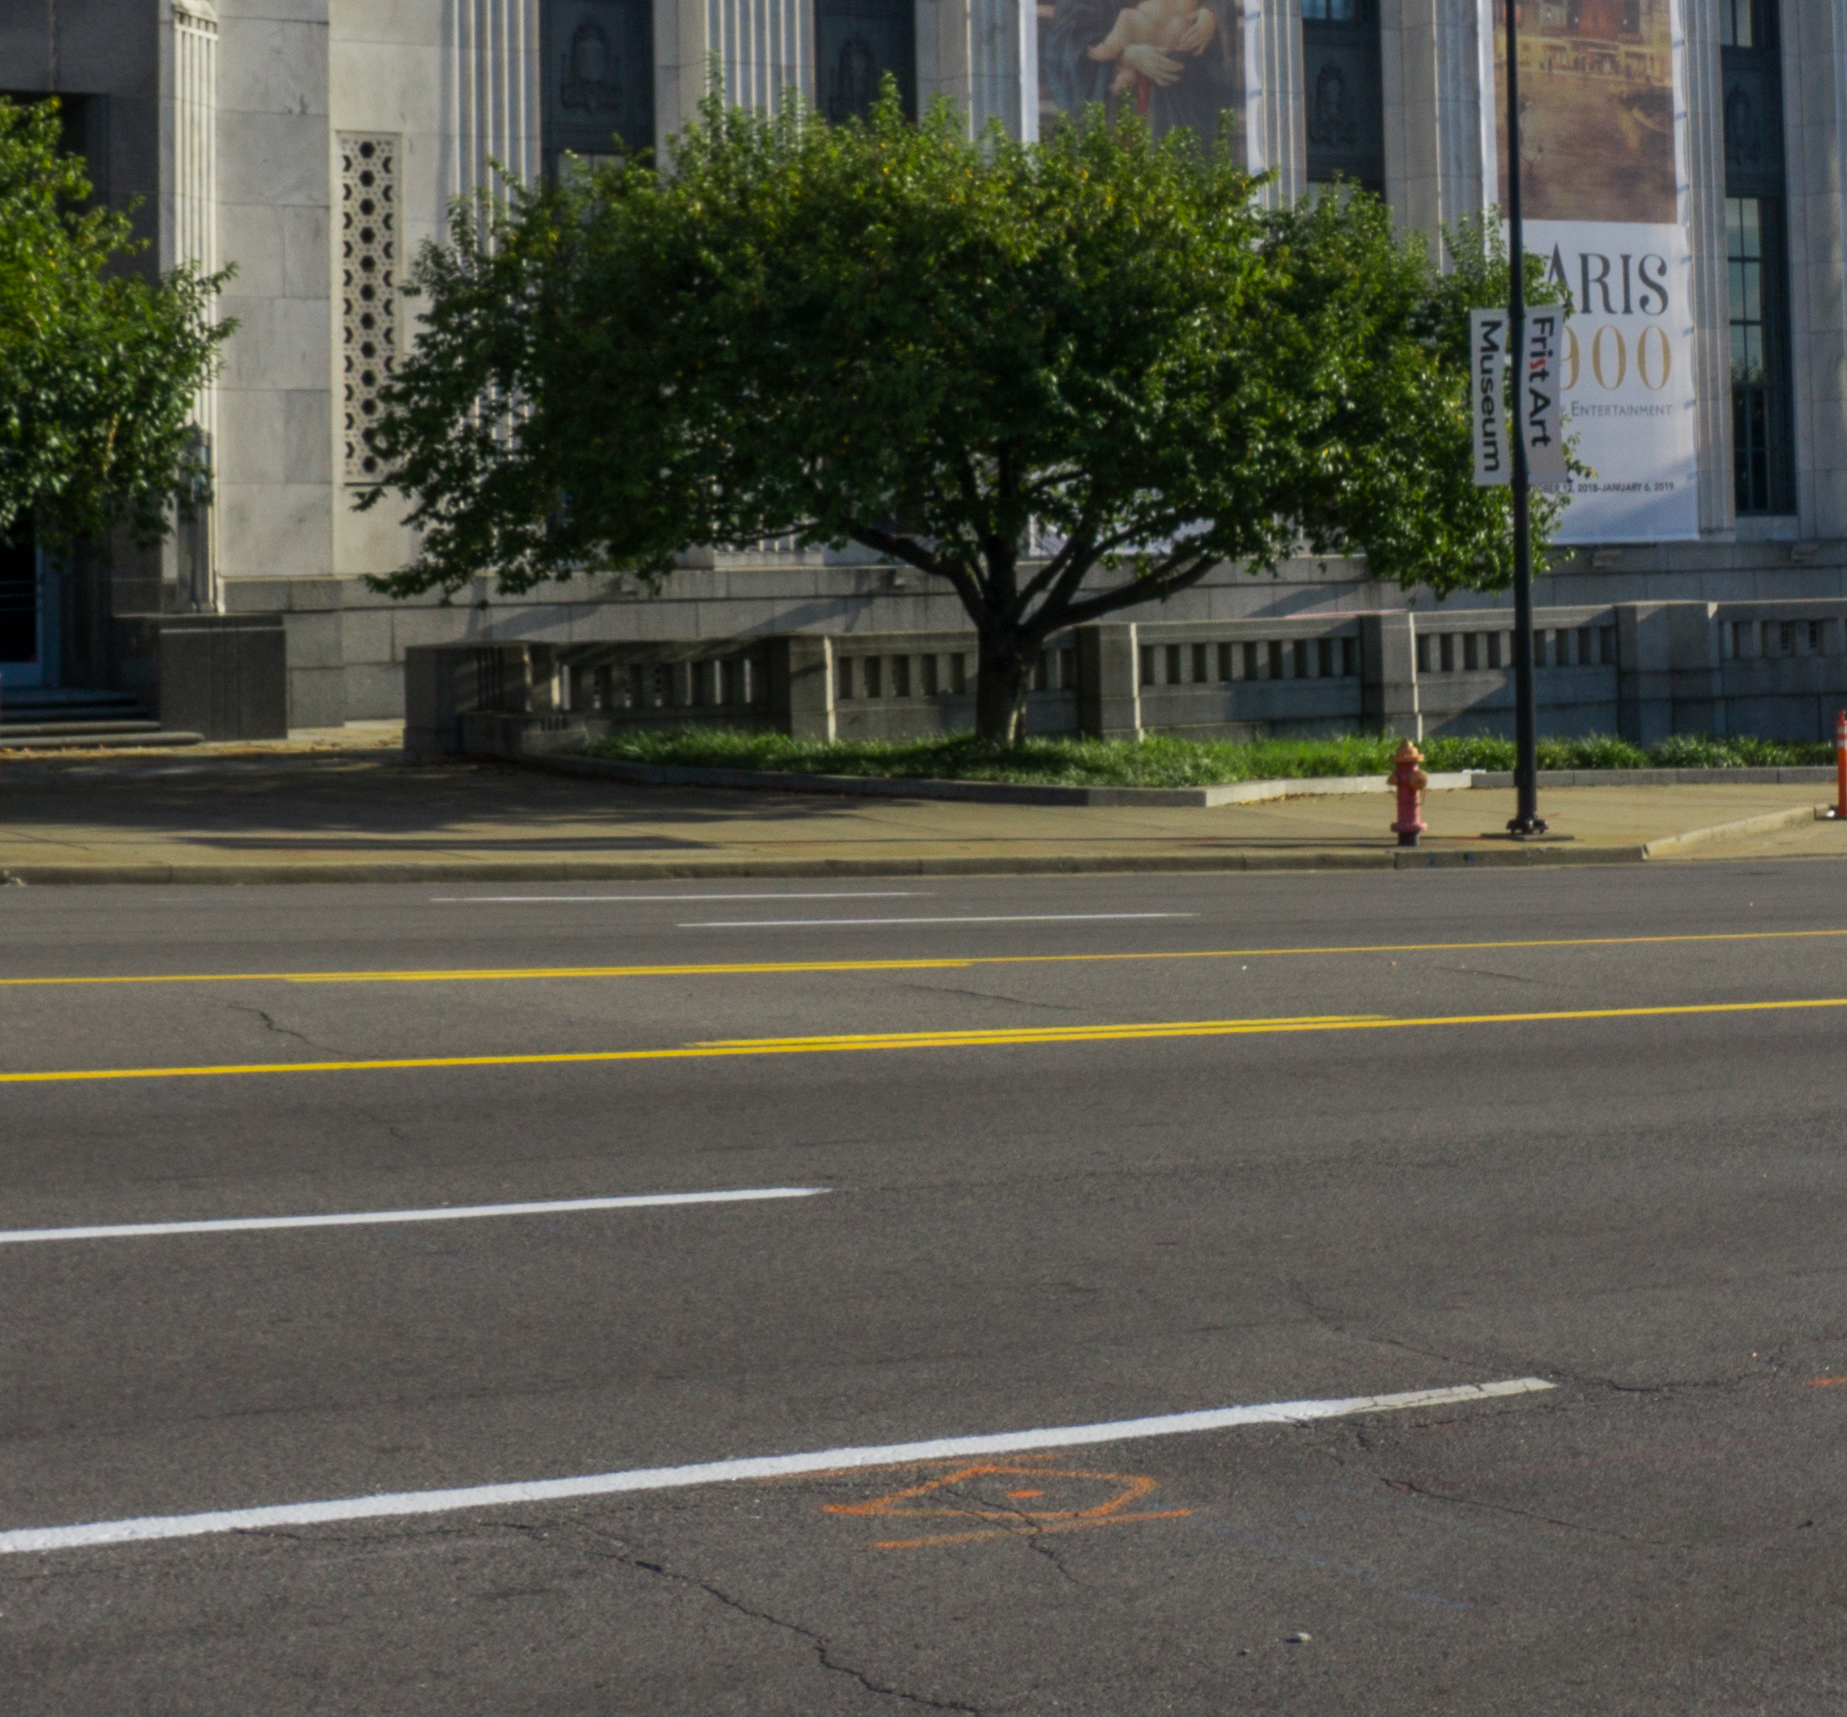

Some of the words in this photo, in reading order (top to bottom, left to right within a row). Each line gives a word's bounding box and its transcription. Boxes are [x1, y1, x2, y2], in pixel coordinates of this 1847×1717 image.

[1547, 241, 1670, 316] ARIS
[1529, 316, 1555, 382] Frist
[1560, 324, 1672, 391] 900
[1479, 320, 1503, 472] Museum
[1529, 387, 1553, 448] Art
[1654, 482, 1674, 492] 2019
